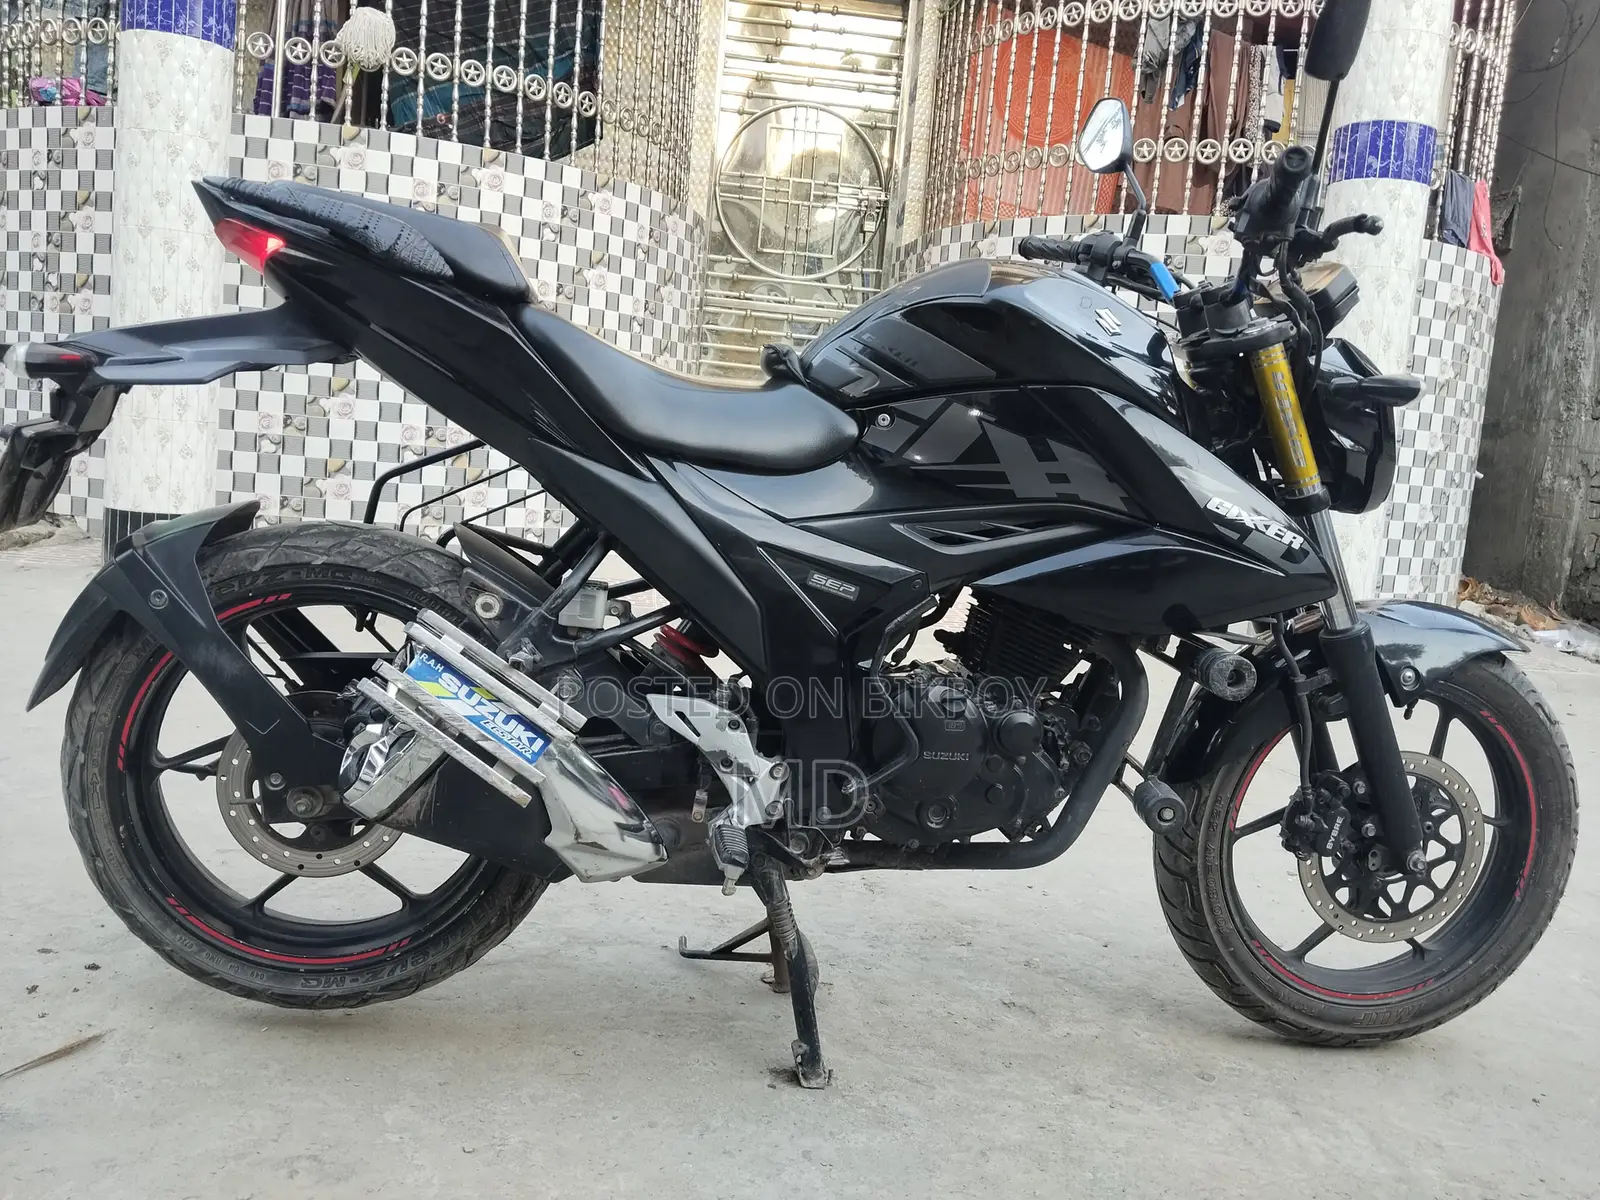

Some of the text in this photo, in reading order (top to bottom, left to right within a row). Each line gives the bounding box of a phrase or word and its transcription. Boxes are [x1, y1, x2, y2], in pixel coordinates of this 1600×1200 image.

[1206, 496, 1305, 550] GIXXER
[810, 573, 856, 592] SEP
[438, 672, 545, 753] SUZUKI
[480, 718, 533, 760] ECSTAR
[923, 750, 970, 761] SUZUKI
[1326, 815, 1345, 850] BYBRE
